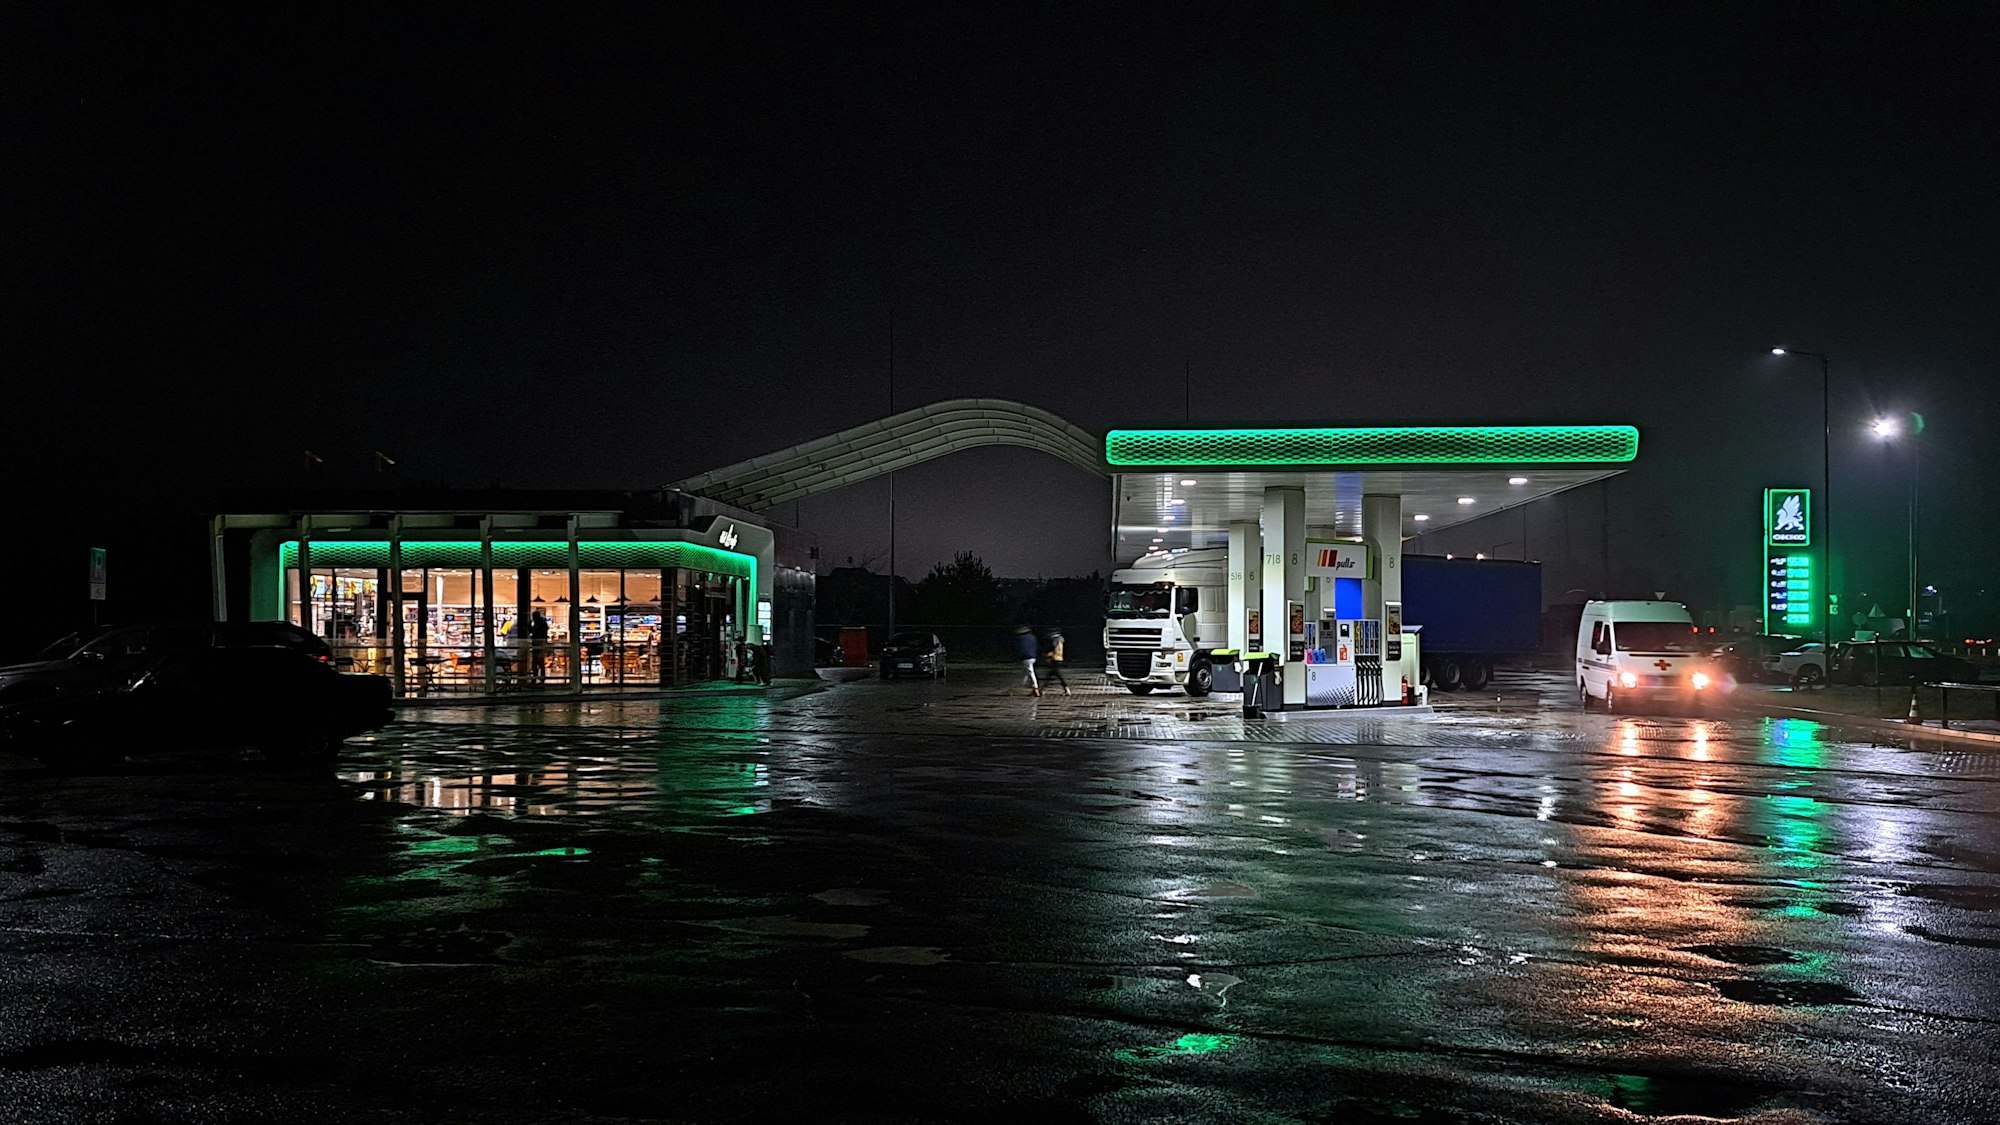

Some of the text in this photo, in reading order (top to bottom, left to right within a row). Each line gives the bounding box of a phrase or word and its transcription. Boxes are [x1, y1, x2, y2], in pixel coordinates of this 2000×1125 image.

[1292, 553, 1298, 565] 8
[1336, 558, 1356, 571] pulls
[1389, 557, 1395, 568] 8
